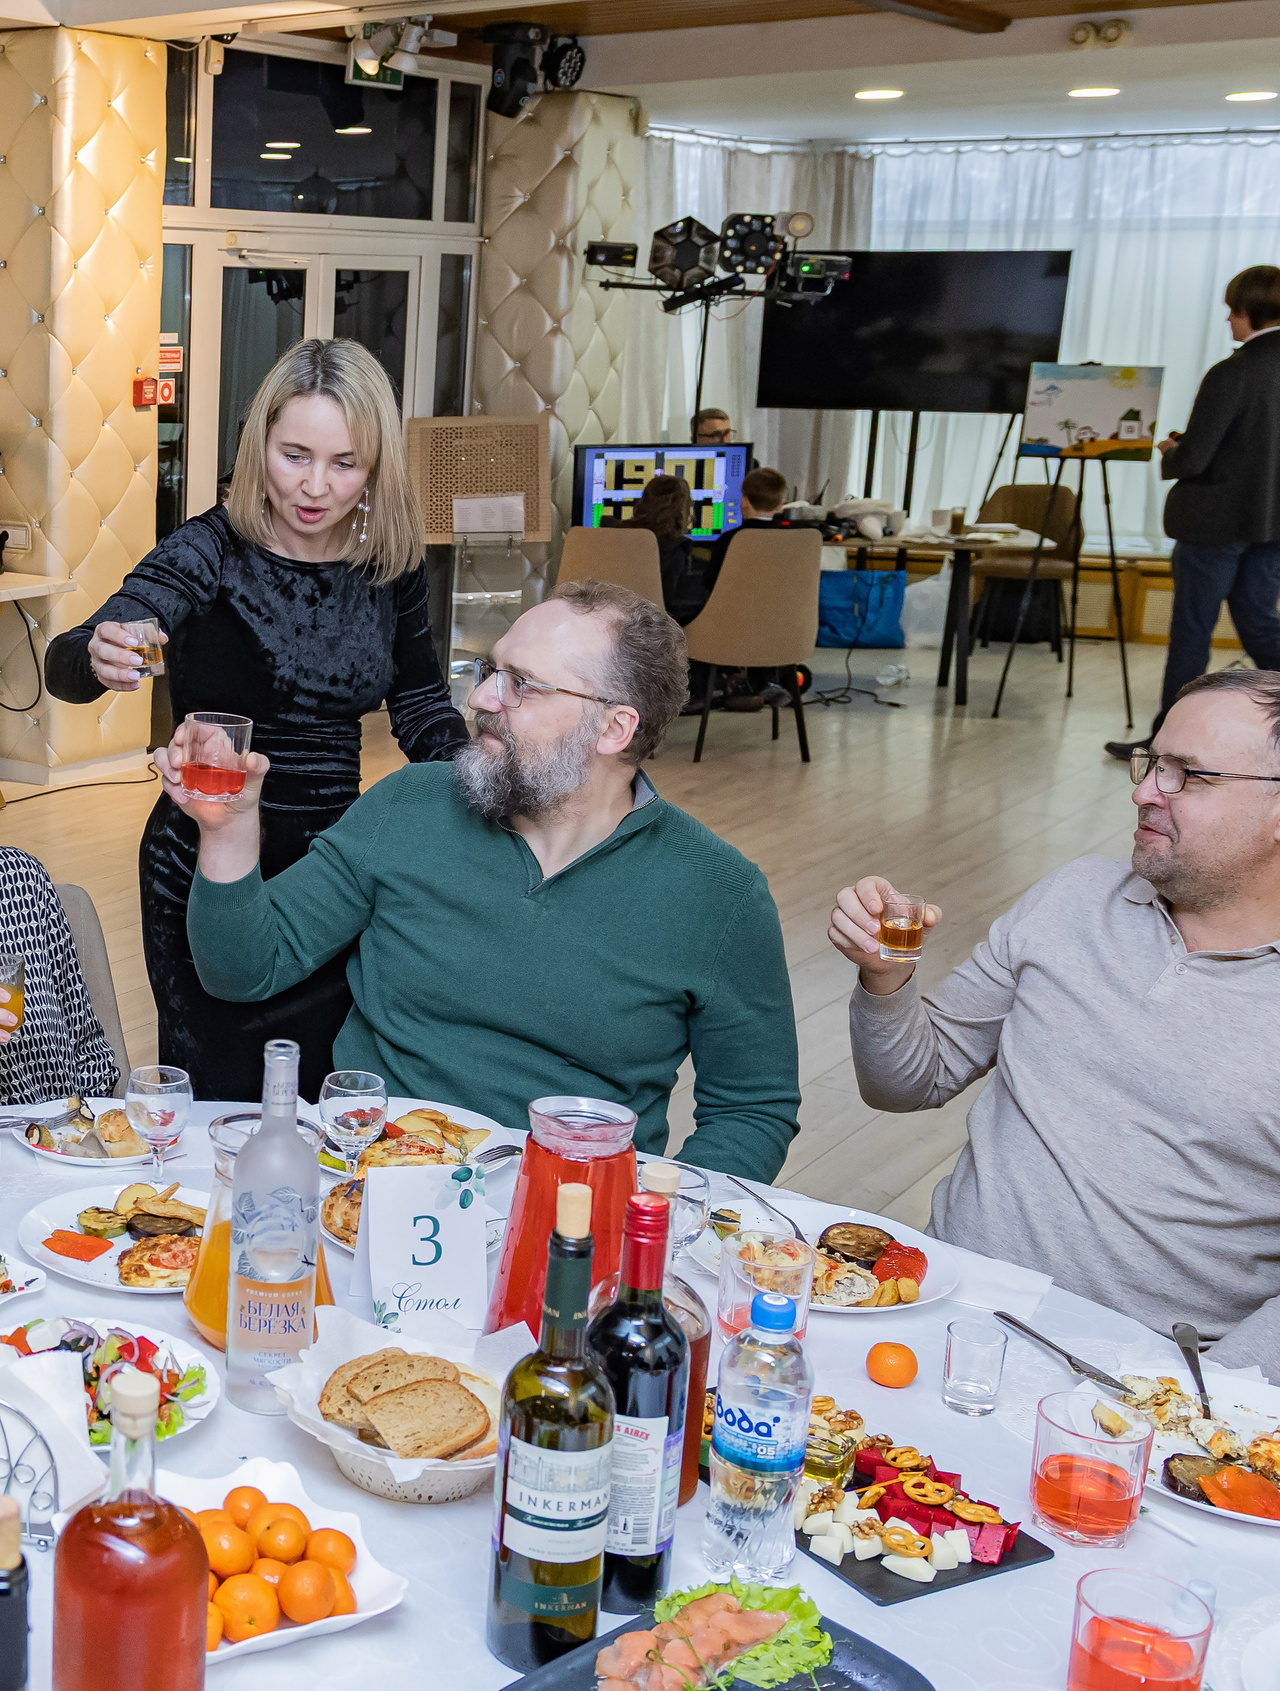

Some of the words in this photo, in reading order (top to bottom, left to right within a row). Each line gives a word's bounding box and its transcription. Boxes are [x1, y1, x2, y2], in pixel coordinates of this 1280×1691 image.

[411, 1215, 442, 1266] 3
[247, 1300, 299, 1318] БЕЛАЯ
[391, 1282, 462, 1315] Стол
[534, 1602, 587, 1611] INKERMAN
